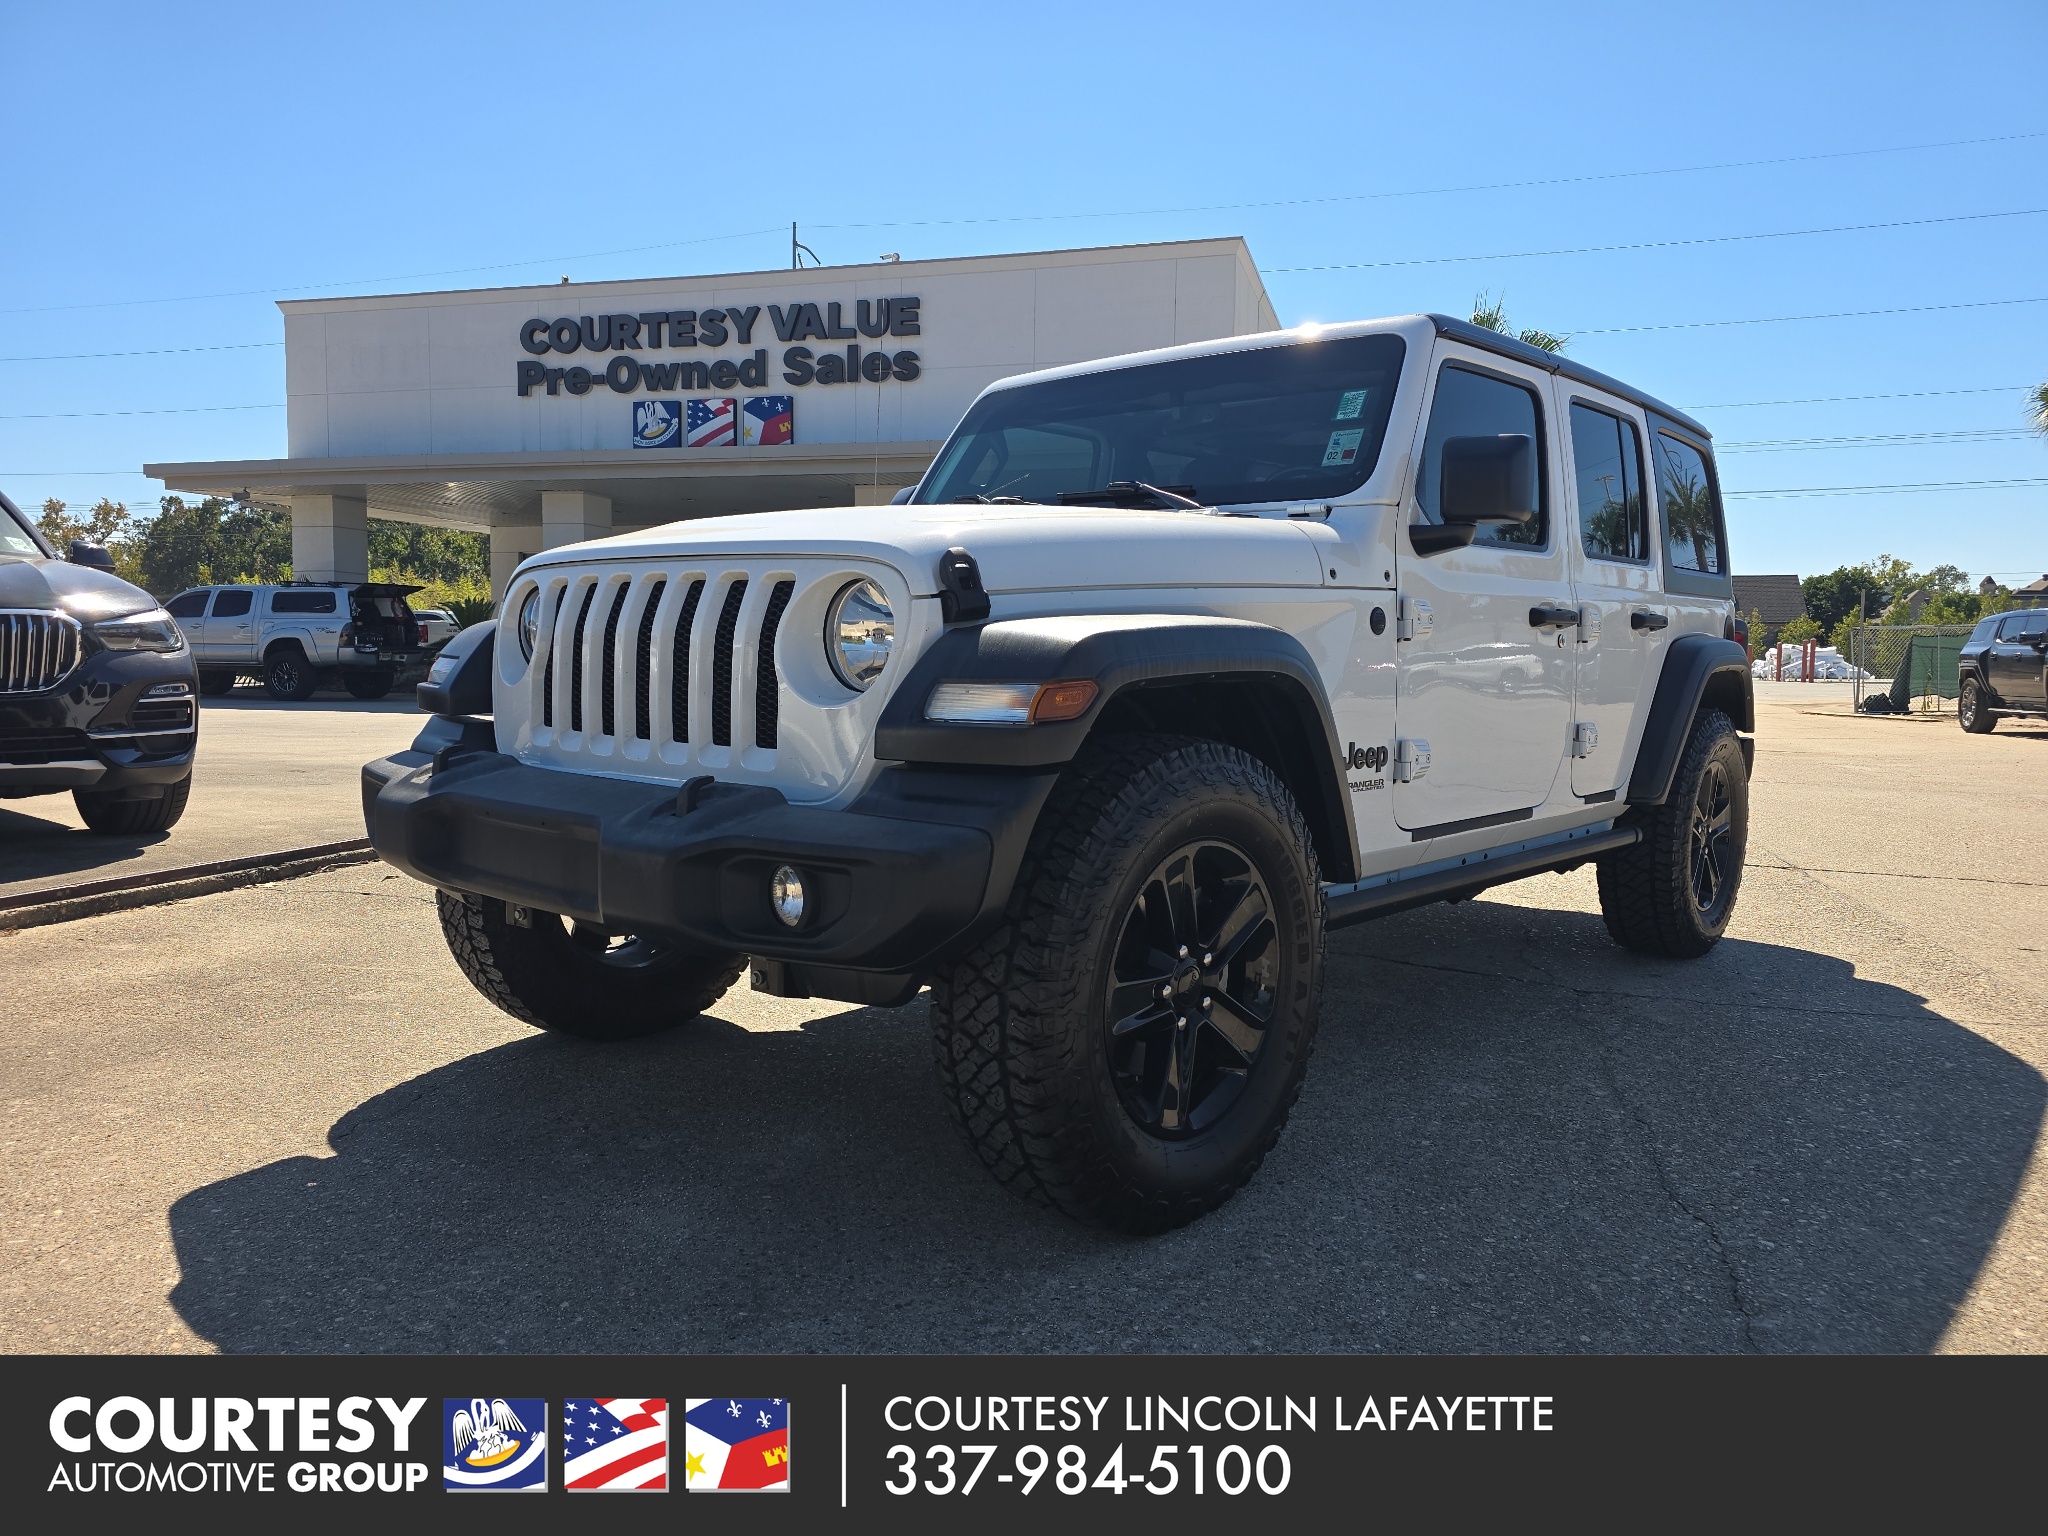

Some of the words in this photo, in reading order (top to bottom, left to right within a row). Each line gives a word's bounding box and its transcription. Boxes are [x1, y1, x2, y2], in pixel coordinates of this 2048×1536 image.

[519, 305, 761, 355] COURTESY
[767, 297, 920, 341] VALUE
[517, 348, 768, 396] Pre-Owned
[783, 344, 920, 386] Sales
[1327, 451, 1338, 460] 02
[1343, 742, 1388, 773] Jeep
[1348, 779, 1384, 788] RANGLER
